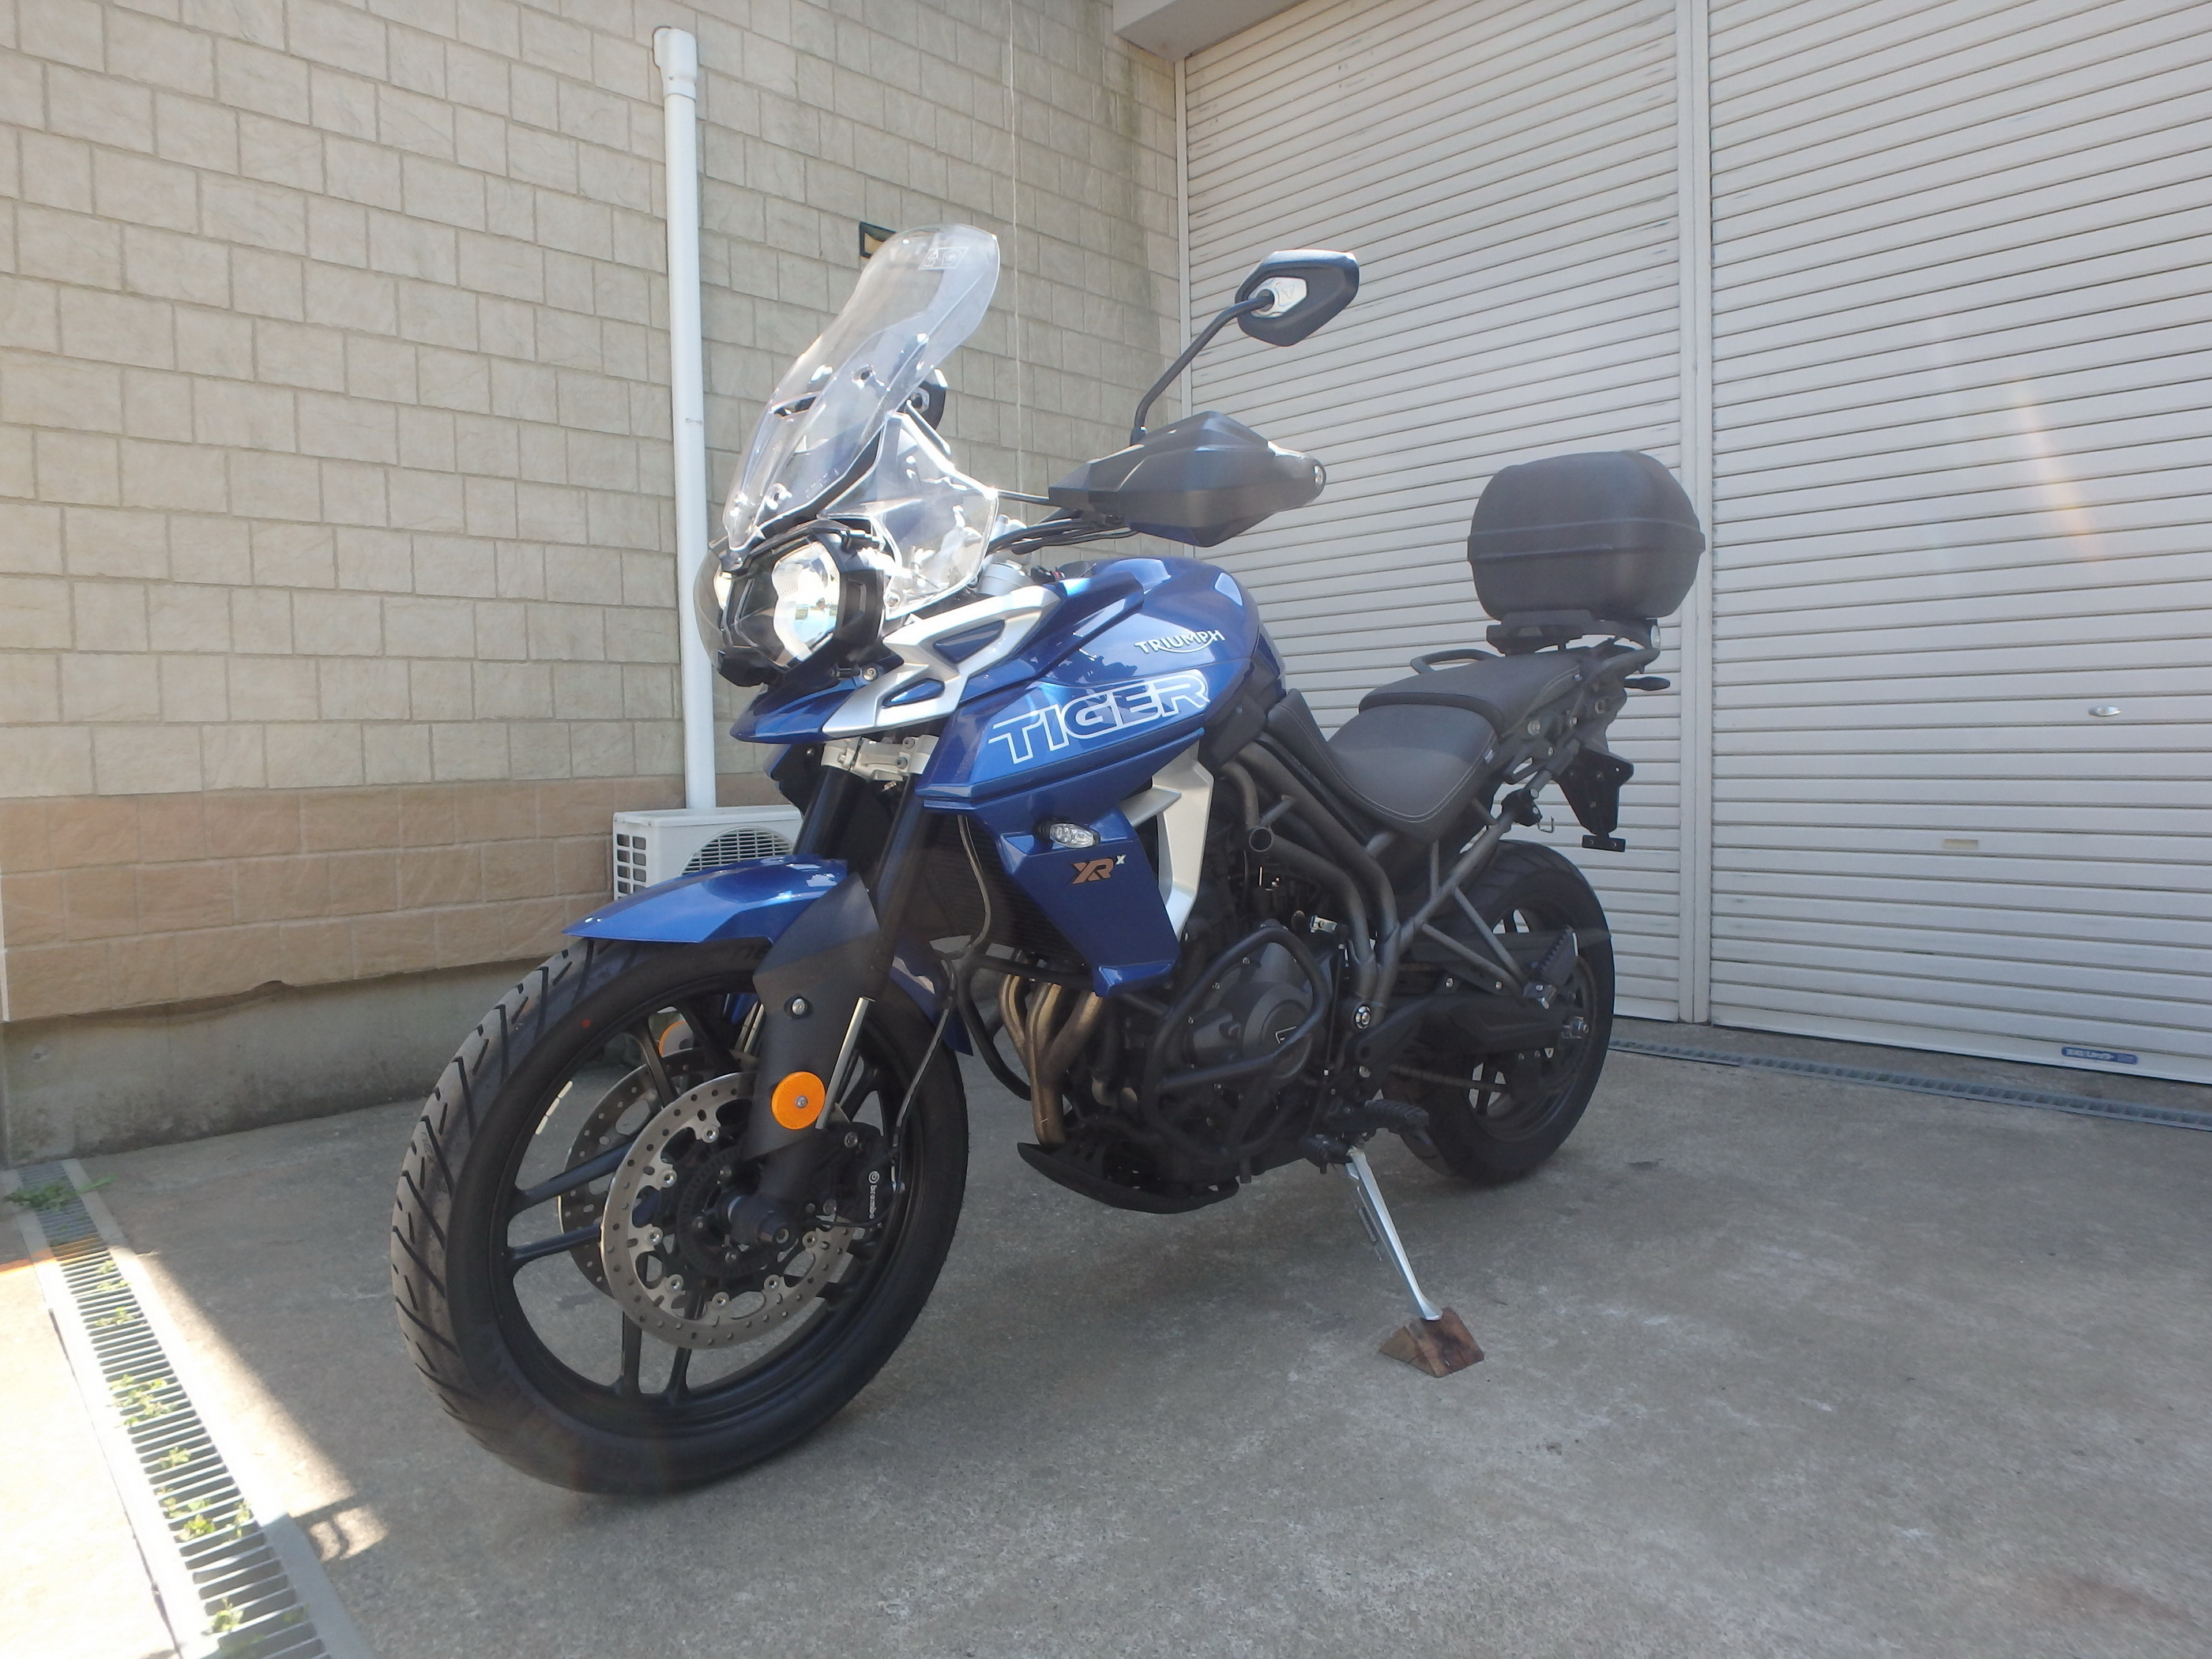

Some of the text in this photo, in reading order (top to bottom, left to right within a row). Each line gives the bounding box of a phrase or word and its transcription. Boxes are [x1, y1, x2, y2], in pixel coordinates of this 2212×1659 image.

[1134, 630, 1225, 654] TRIUMPH
[988, 669, 1210, 764] TIGER
[869, 1184, 878, 1220] brembo
